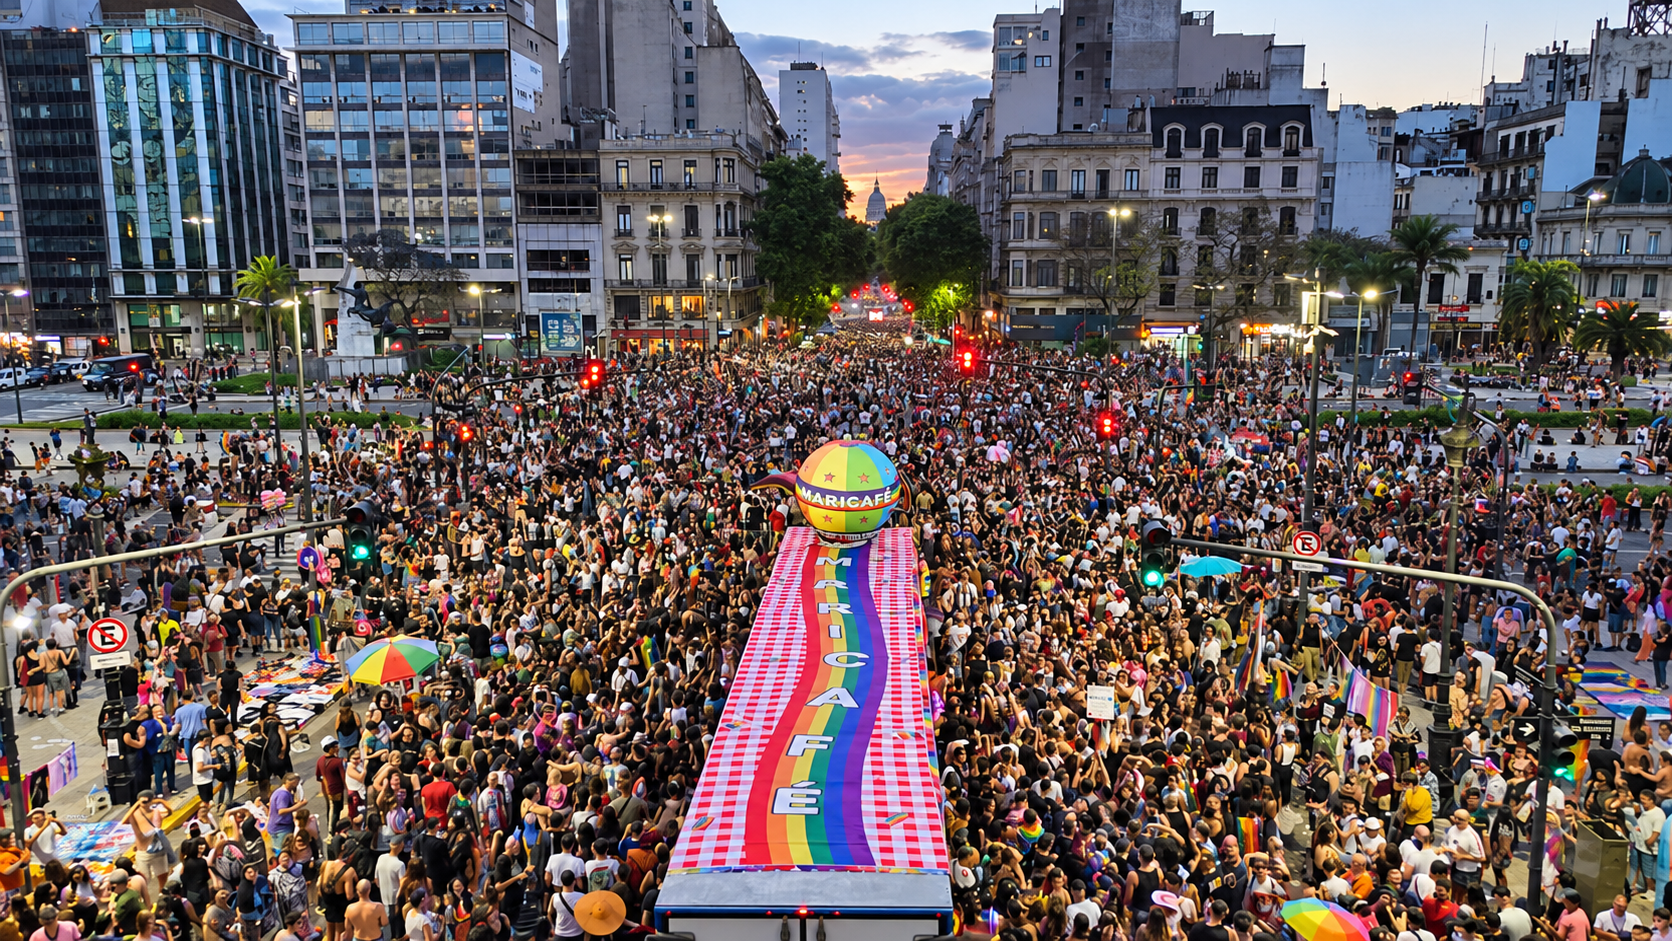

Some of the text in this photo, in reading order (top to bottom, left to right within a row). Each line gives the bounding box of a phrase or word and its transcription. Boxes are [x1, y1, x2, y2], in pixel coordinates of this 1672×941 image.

[801, 486, 892, 508] MARICAFÉ
[1301, 536, 1314, 551] E
[100, 625, 116, 646] E
